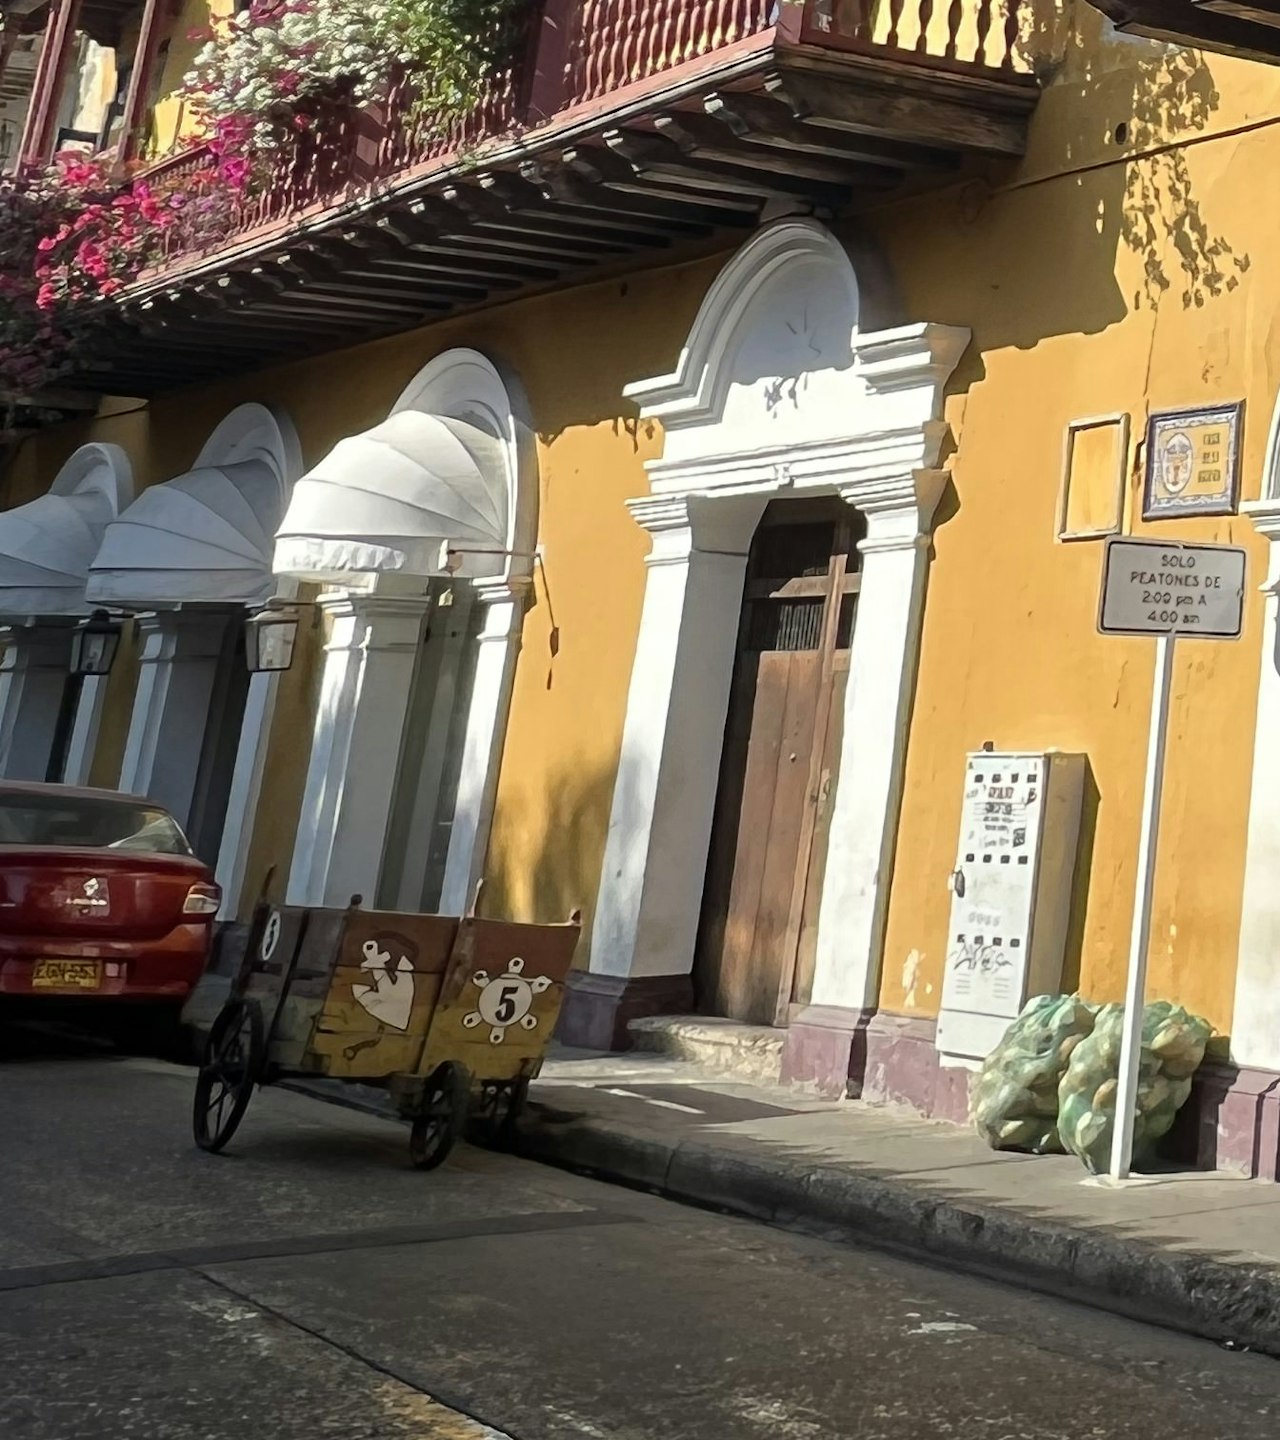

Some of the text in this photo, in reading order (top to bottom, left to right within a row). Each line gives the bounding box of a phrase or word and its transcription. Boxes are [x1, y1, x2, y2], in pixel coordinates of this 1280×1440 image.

[1161, 554, 1196, 568] SOLO
[1130, 571, 1221, 589] PEATONES DE
[1198, 594, 1207, 606] A
[494, 986, 519, 1023] 5
